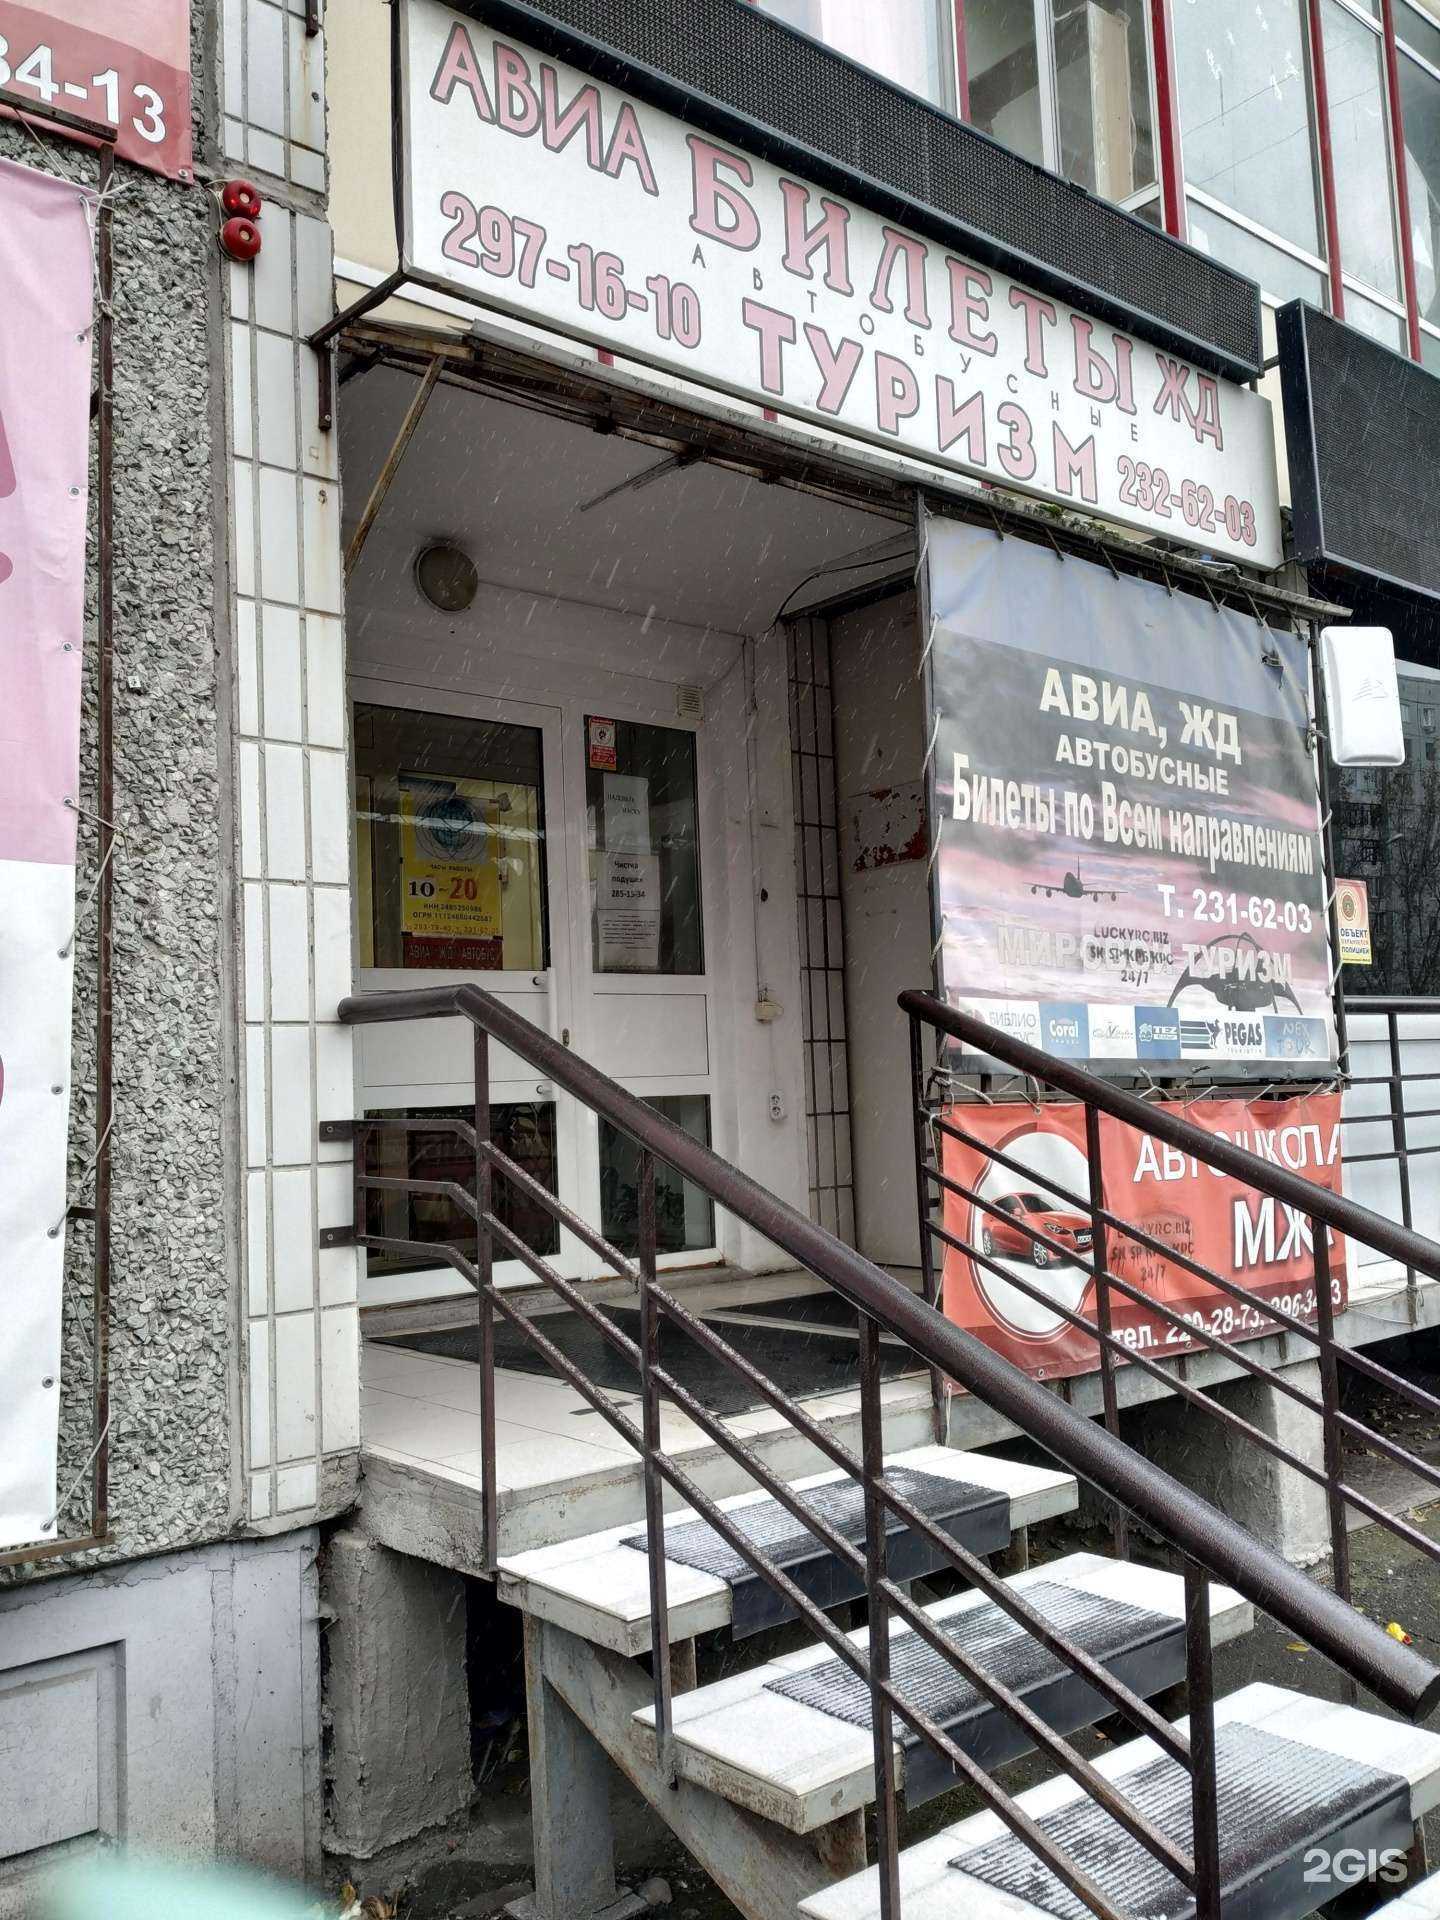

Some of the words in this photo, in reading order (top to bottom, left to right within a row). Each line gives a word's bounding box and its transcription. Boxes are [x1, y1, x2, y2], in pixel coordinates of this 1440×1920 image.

[430, 21, 659, 197] АВИА
[686, 133, 1137, 416] БИЛЕТЫ
[1153, 352, 1224, 451] ЖД
[440, 190, 701, 349] 297-16-10
[742, 297, 1098, 504] ТУРИЗМ
[1117, 454, 1257, 547] 232-62-03
[1039, 667, 1168, 749] АВИА,
[1179, 701, 1242, 765] ЖД
[1055, 734, 1229, 796] АВТОБУСНЫЕ
[952, 752, 1055, 834] Билеты
[1064, 790, 1094, 840] по
[1101, 781, 1162, 850] Всем
[1169, 811, 1314, 876] направлениям
[408, 880, 435, 898] 10
[449, 876, 478, 901] 20
[1193, 889, 1312, 934] 231-62-03
[1340, 927, 1368, 938] ОБЪЕКТ
[1050, 1020, 1079, 1039] Coral
[1224, 1022, 1263, 1046] PEGAS
[1234, 1197, 1335, 1268] МЖ
